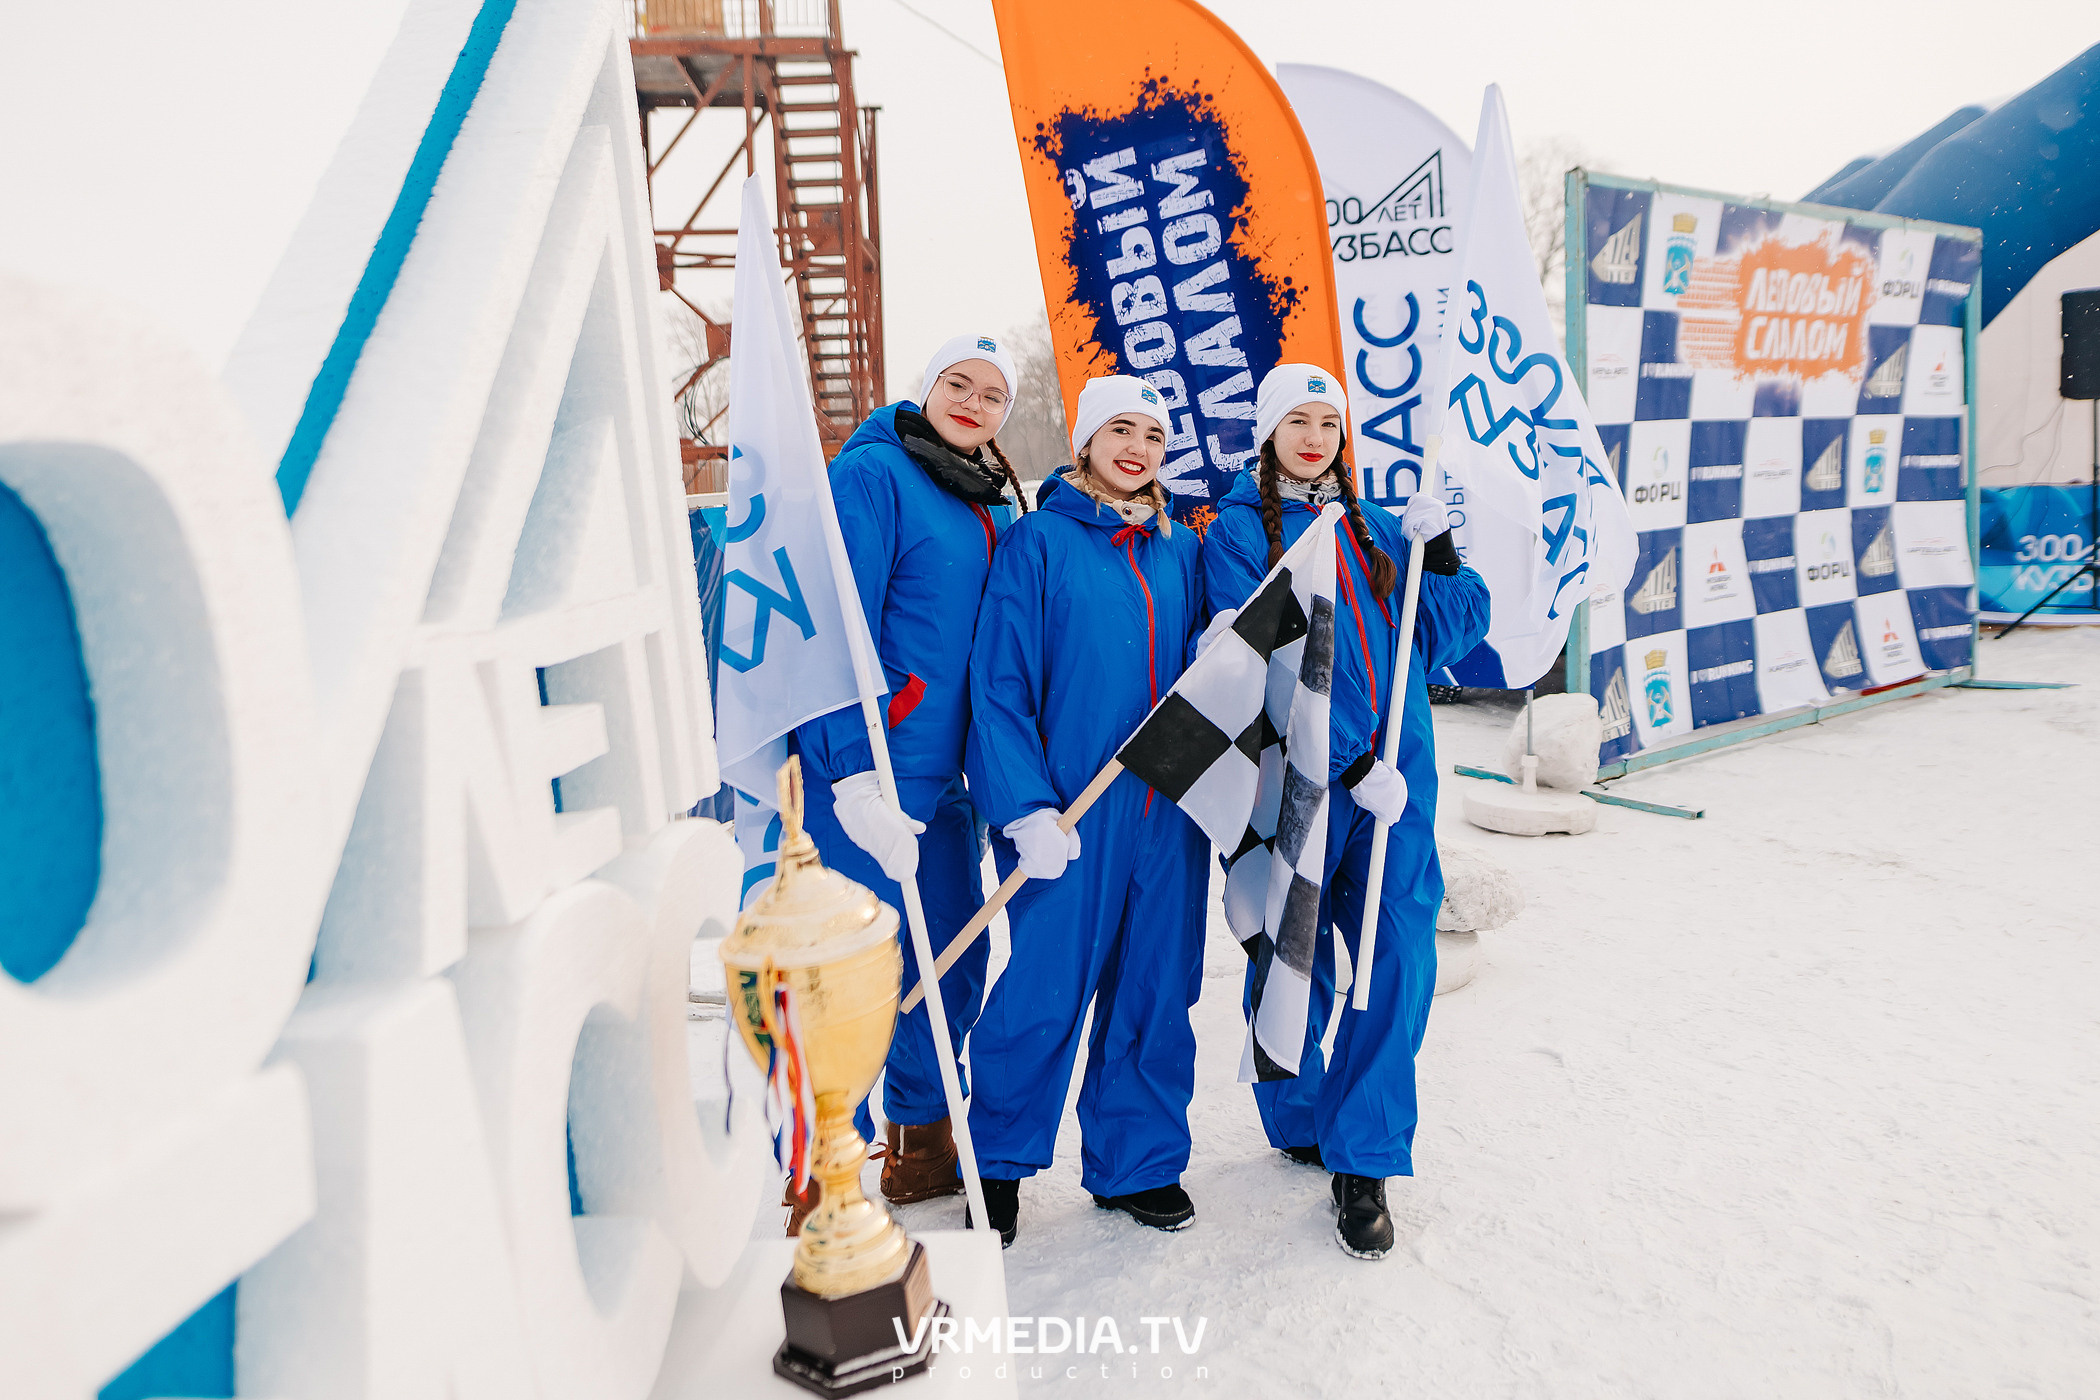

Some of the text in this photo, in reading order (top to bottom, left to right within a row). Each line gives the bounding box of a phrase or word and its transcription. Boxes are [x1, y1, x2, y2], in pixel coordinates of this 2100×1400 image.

[1377, 203, 1422, 223] ЛЕТ
[1332, 226, 1453, 262] ЗБАСС
[1745, 262, 1864, 317] ЛЕДОВЫЙ
[1151, 148, 1260, 473] СЛАЛОМ
[1746, 316, 1849, 360] СЛАЛОМ
[1353, 291, 1425, 508] БАСС
[1634, 481, 1681, 503] ФОРЦ
[1807, 559, 1850, 581] ФОРЦ
